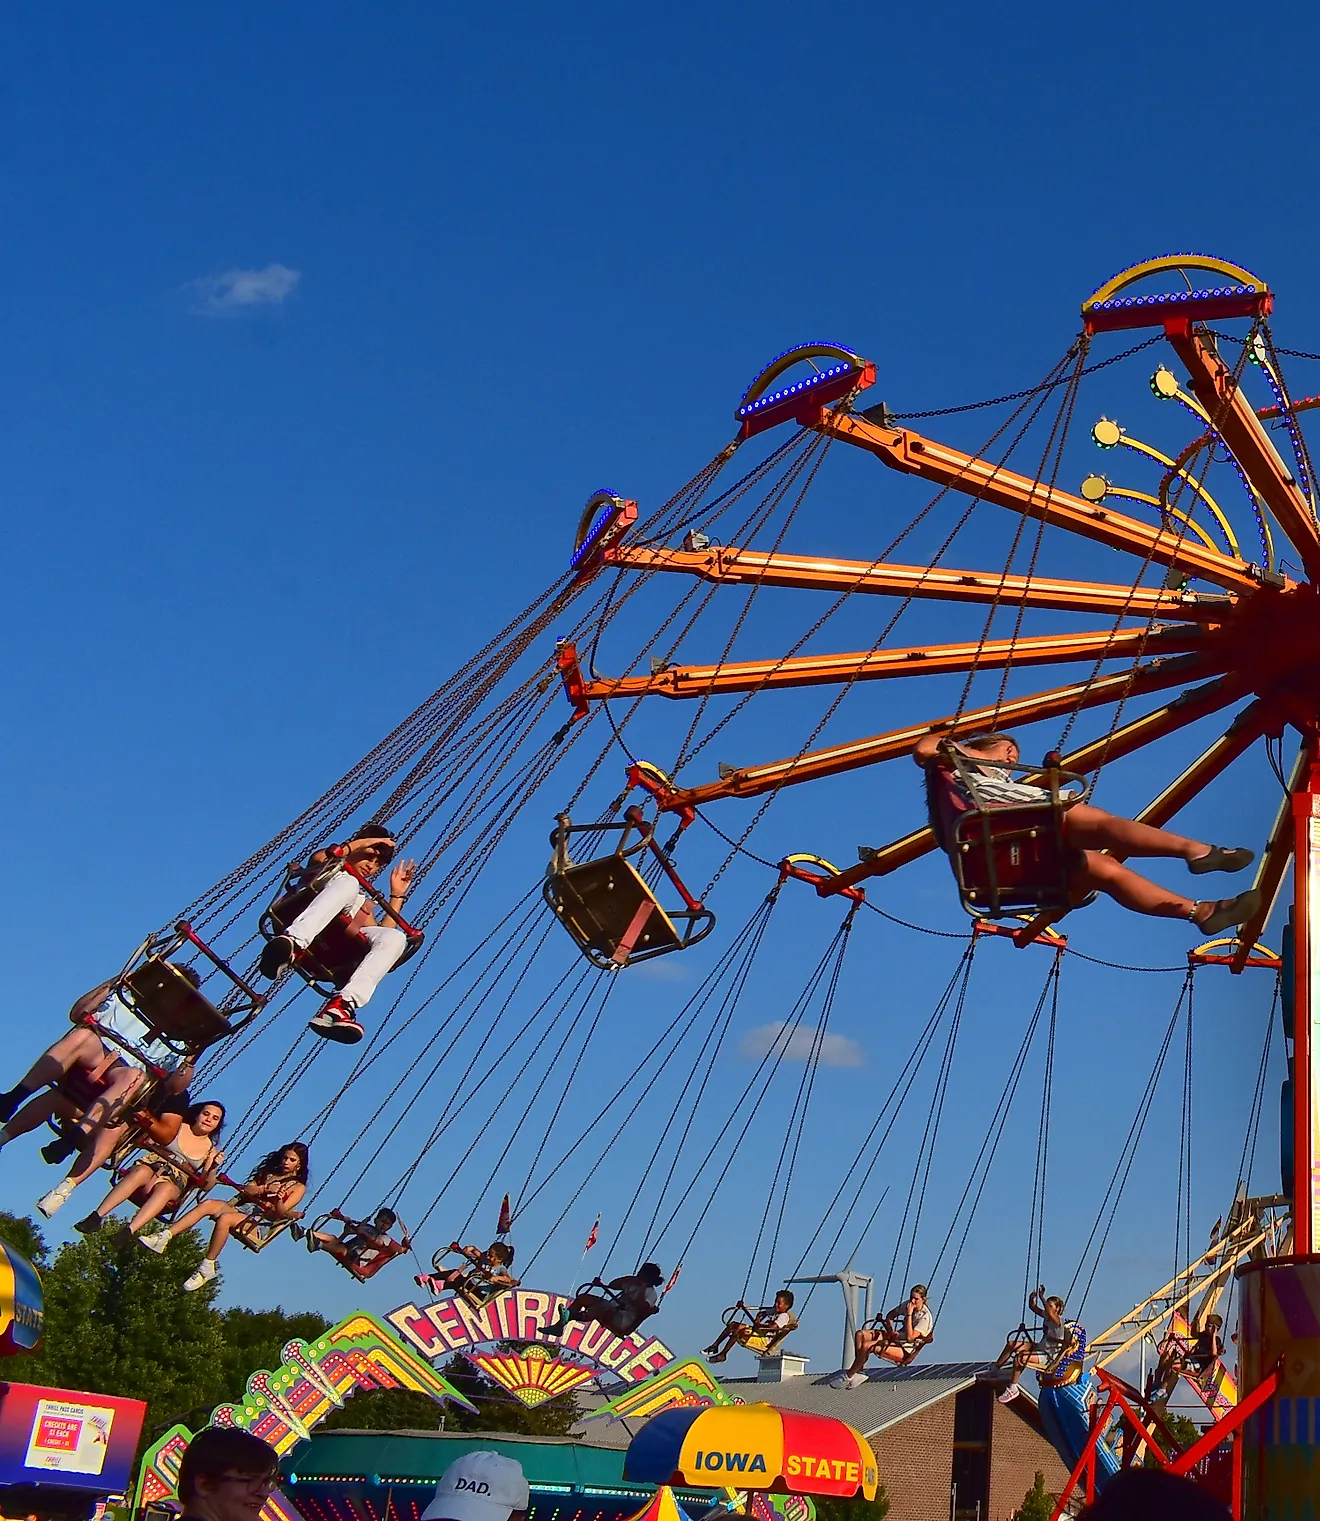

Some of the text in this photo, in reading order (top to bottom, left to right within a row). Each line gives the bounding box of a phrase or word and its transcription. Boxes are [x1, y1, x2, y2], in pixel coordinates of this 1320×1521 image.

[44, 1420, 67, 1430] CREDITS
[67, 1422, 78, 1430] ARE
[56, 1430, 70, 1438] EACH
[694, 1451, 767, 1473] IOWA
[787, 1455, 860, 1482] STATE
[455, 1477, 492, 1497] DAD.
